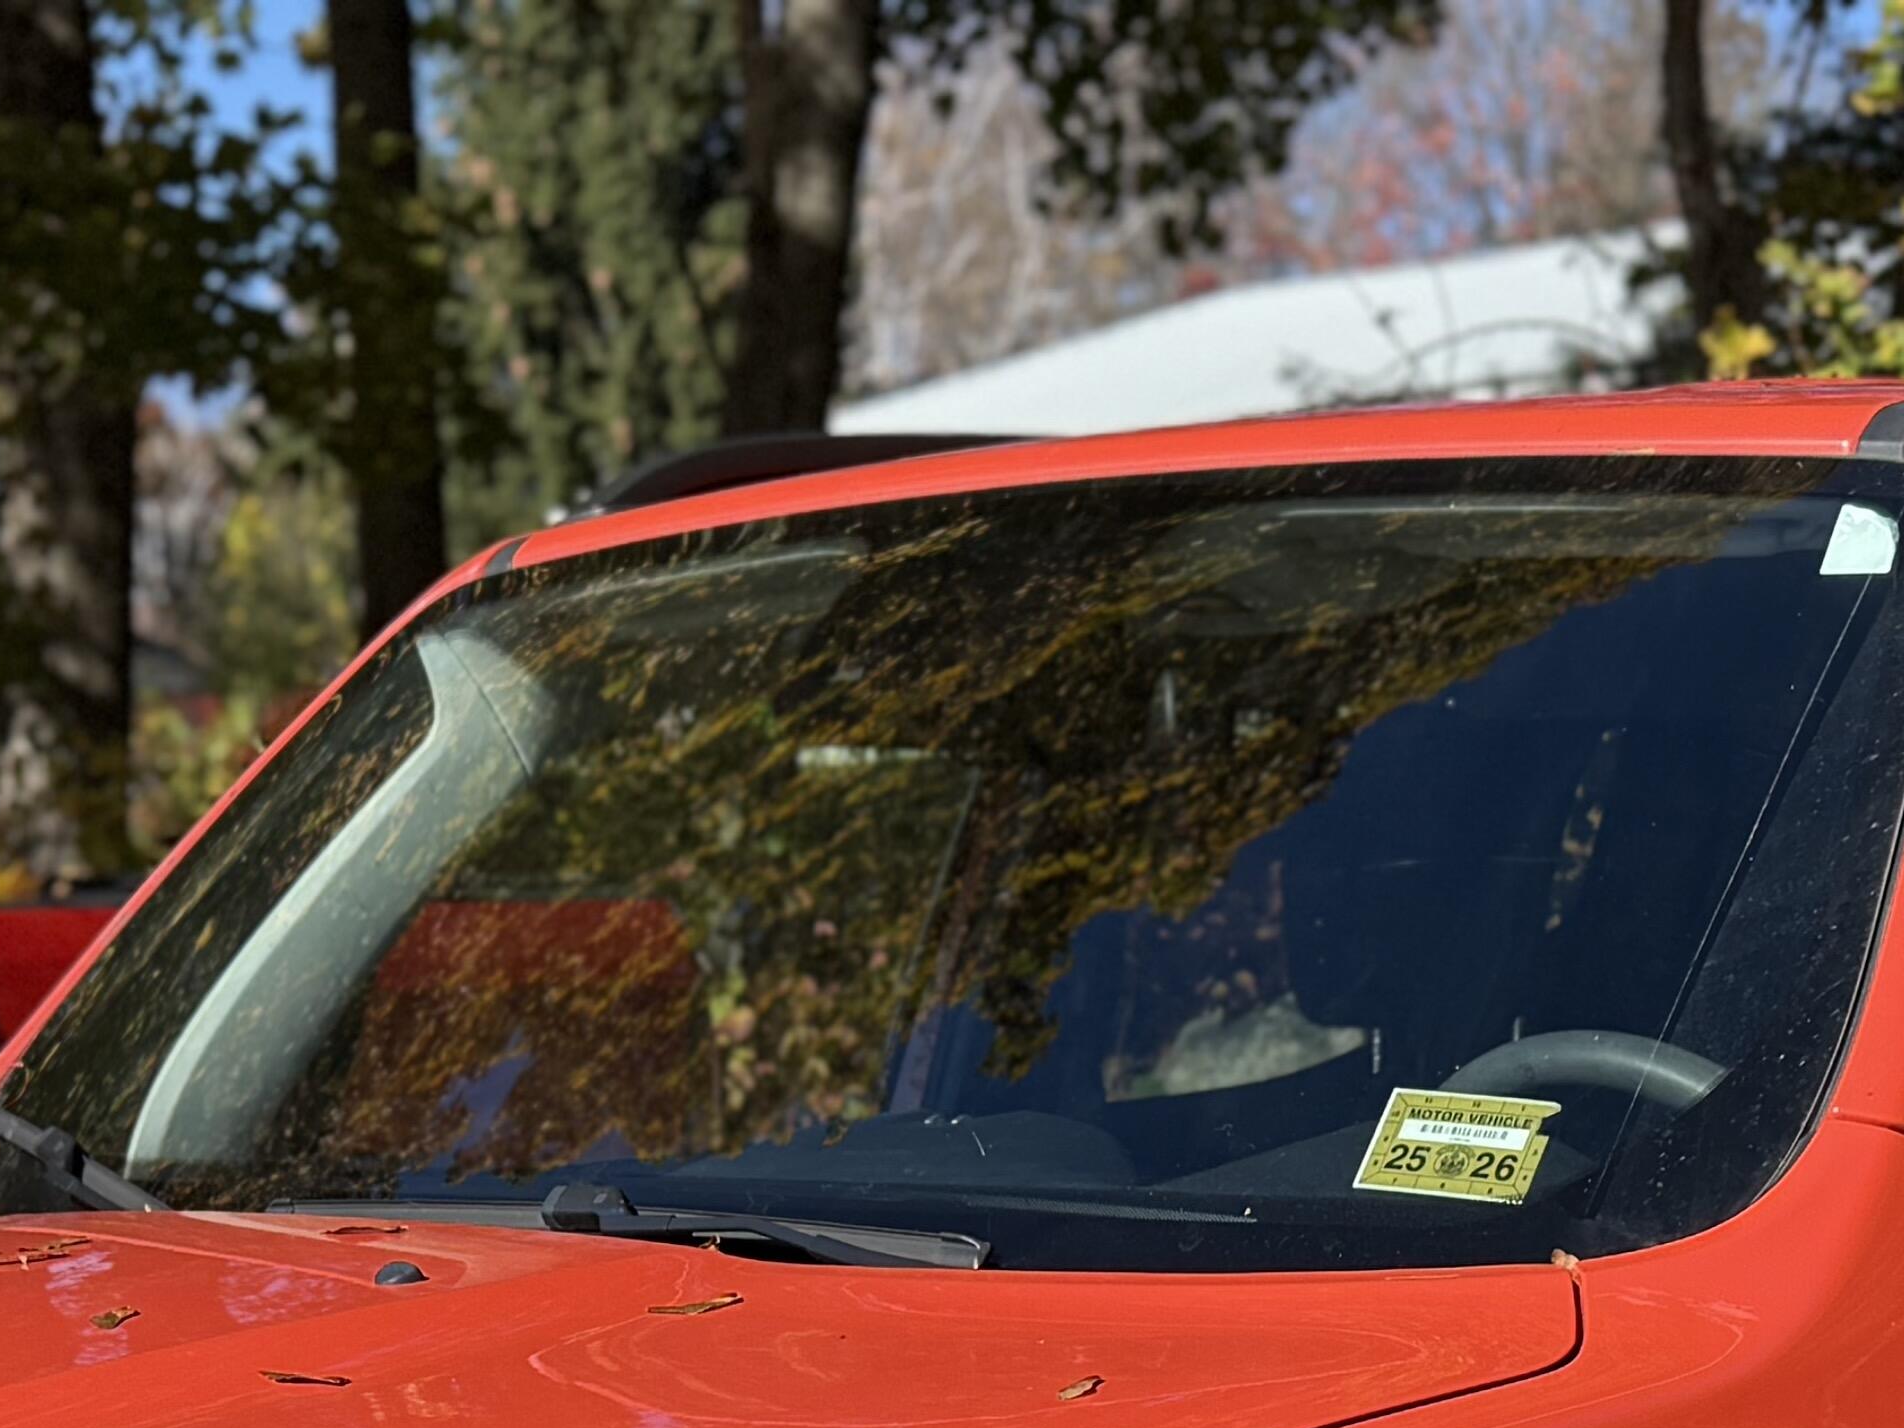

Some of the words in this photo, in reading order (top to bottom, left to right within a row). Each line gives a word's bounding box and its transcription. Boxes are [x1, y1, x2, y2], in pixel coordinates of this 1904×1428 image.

[1407, 1107, 1464, 1123] MOTOR
[1469, 1112, 1534, 1129] VEHICLE
[1383, 1143, 1431, 1172] 25
[1469, 1151, 1519, 1182] 26
